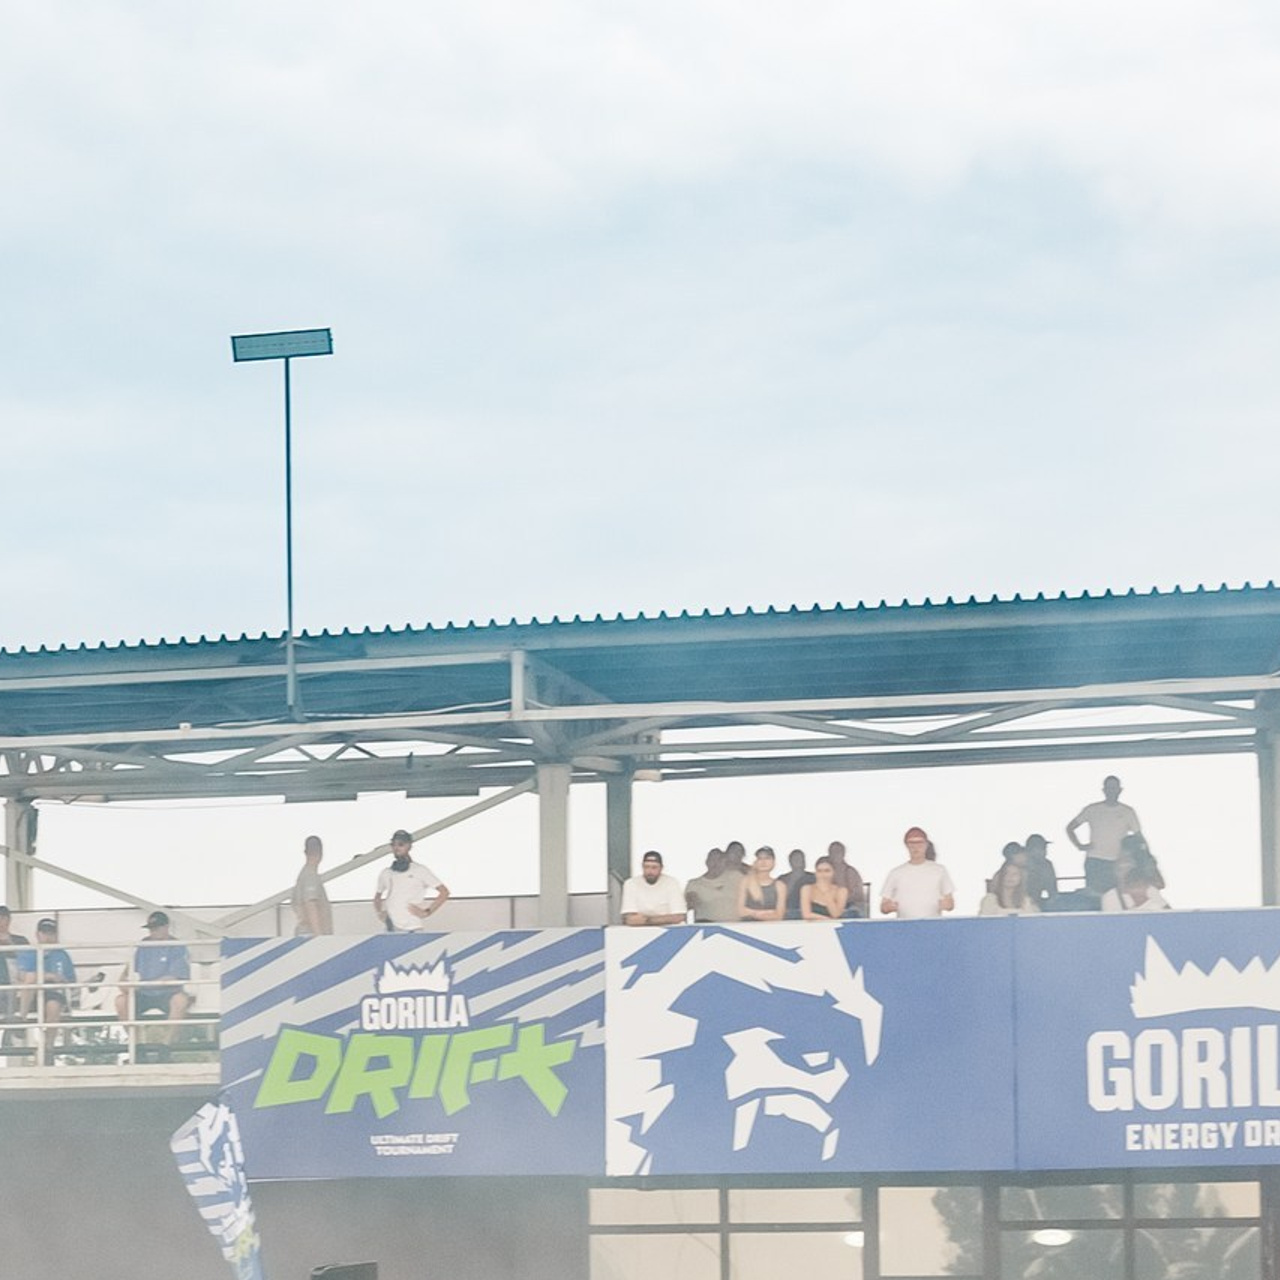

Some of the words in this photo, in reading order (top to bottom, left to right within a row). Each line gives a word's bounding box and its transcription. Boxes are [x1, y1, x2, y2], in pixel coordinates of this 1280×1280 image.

[361, 994, 469, 1031] GORILLA
[252, 1022, 576, 1120] DRIFT
[425, 1133, 459, 1145] DRIFT
[1125, 1123, 1238, 1151] ENERGY
